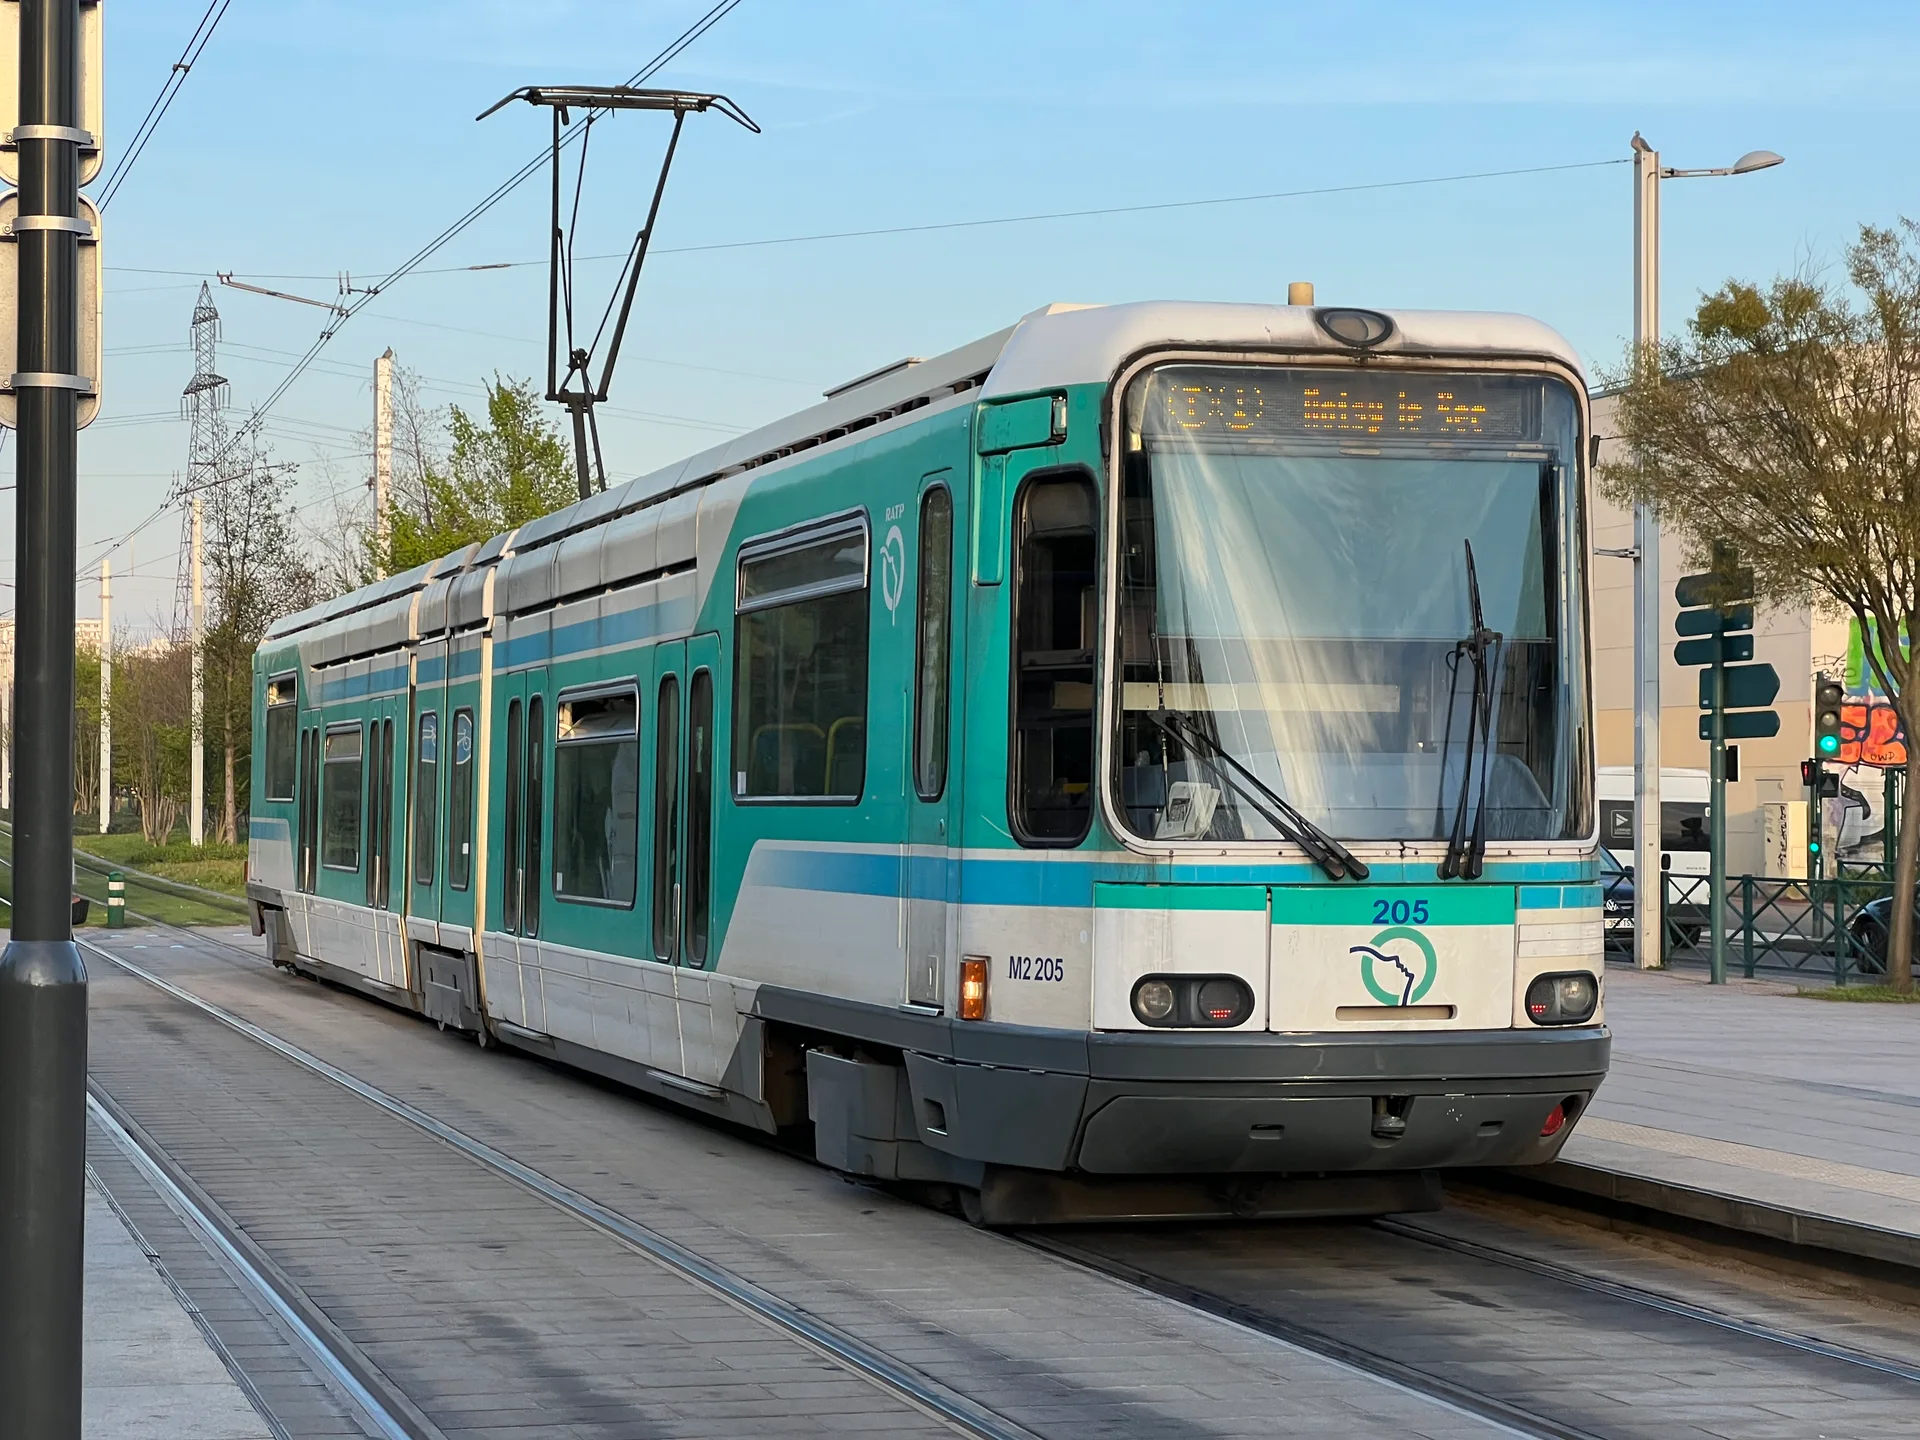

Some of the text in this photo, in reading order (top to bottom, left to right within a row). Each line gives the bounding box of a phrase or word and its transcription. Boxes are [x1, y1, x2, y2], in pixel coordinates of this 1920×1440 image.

[885, 503, 905, 522] RATP
[1372, 899, 1429, 925] 205
[1034, 957, 1064, 982] 205
